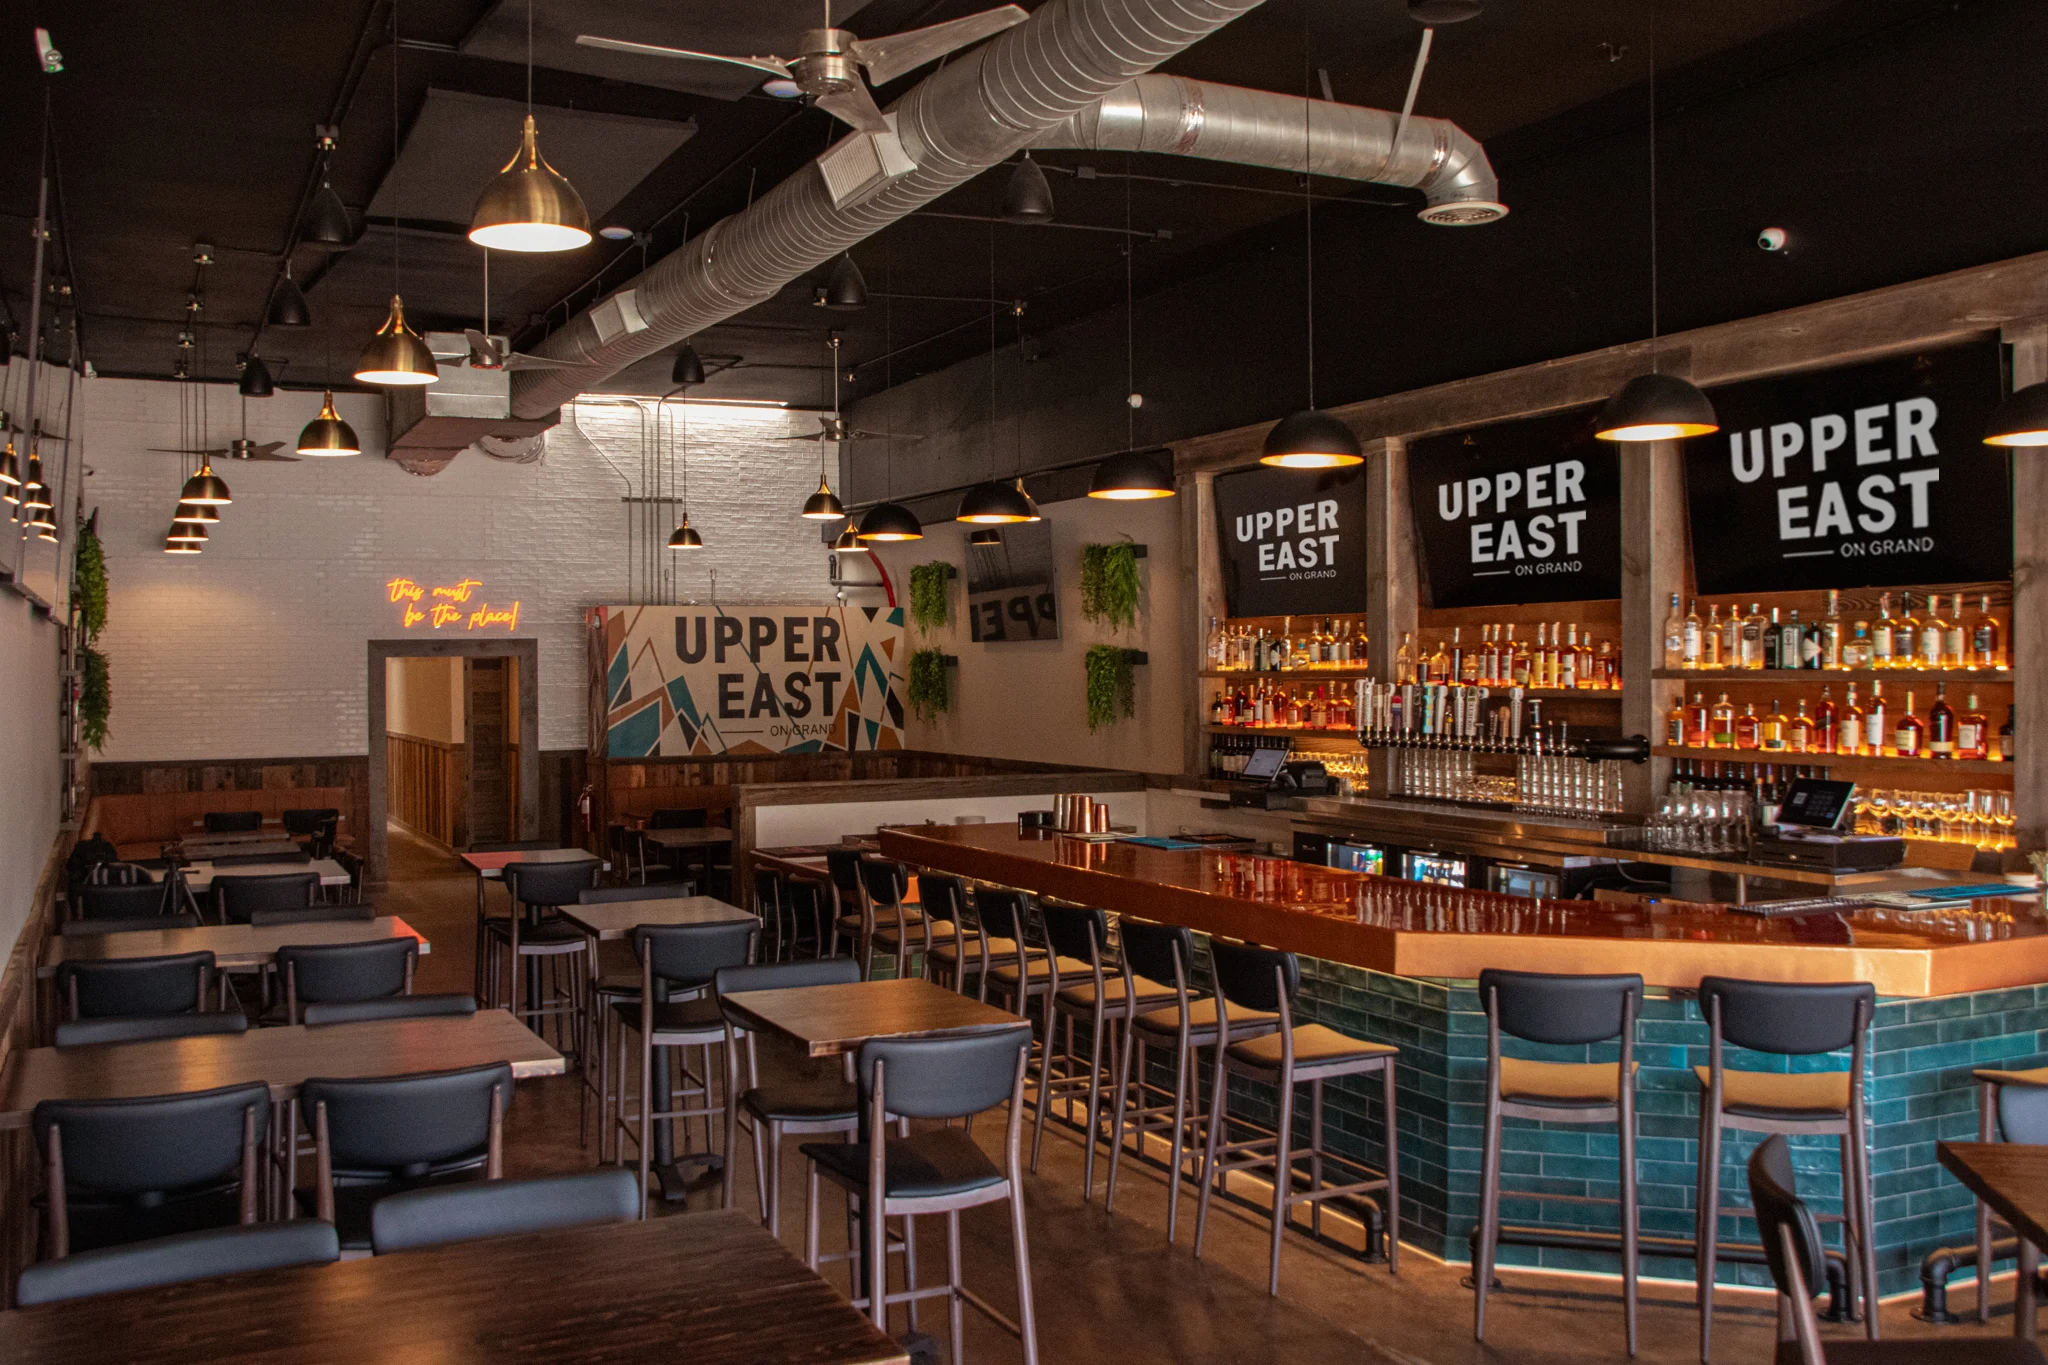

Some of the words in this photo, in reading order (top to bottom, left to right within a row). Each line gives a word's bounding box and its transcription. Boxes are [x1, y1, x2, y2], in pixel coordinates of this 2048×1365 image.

[1729, 397, 1940, 483] UPPER
[1438, 459, 1587, 521] UPPER
[1777, 467, 1940, 540] EAST
[1236, 499, 1340, 543] UPPER
[1470, 510, 1587, 563] EAST
[1258, 534, 1340, 572] EAST
[1840, 543, 1866, 558] ON
[1868, 536, 1934, 556] GRAND
[1289, 572, 1303, 581] ON
[1303, 569, 1337, 580] GRAND
[1514, 565, 1534, 577] ON
[1535, 560, 1583, 575] GRAND
[386, 577, 425, 603] this
[431, 578, 483, 603] must
[404, 602, 425, 628] be
[430, 602, 462, 627] the
[675, 616, 841, 664] UPPER
[718, 672, 841, 719] EAST
[770, 726, 789, 737] ON
[792, 724, 836, 735] GRAND
